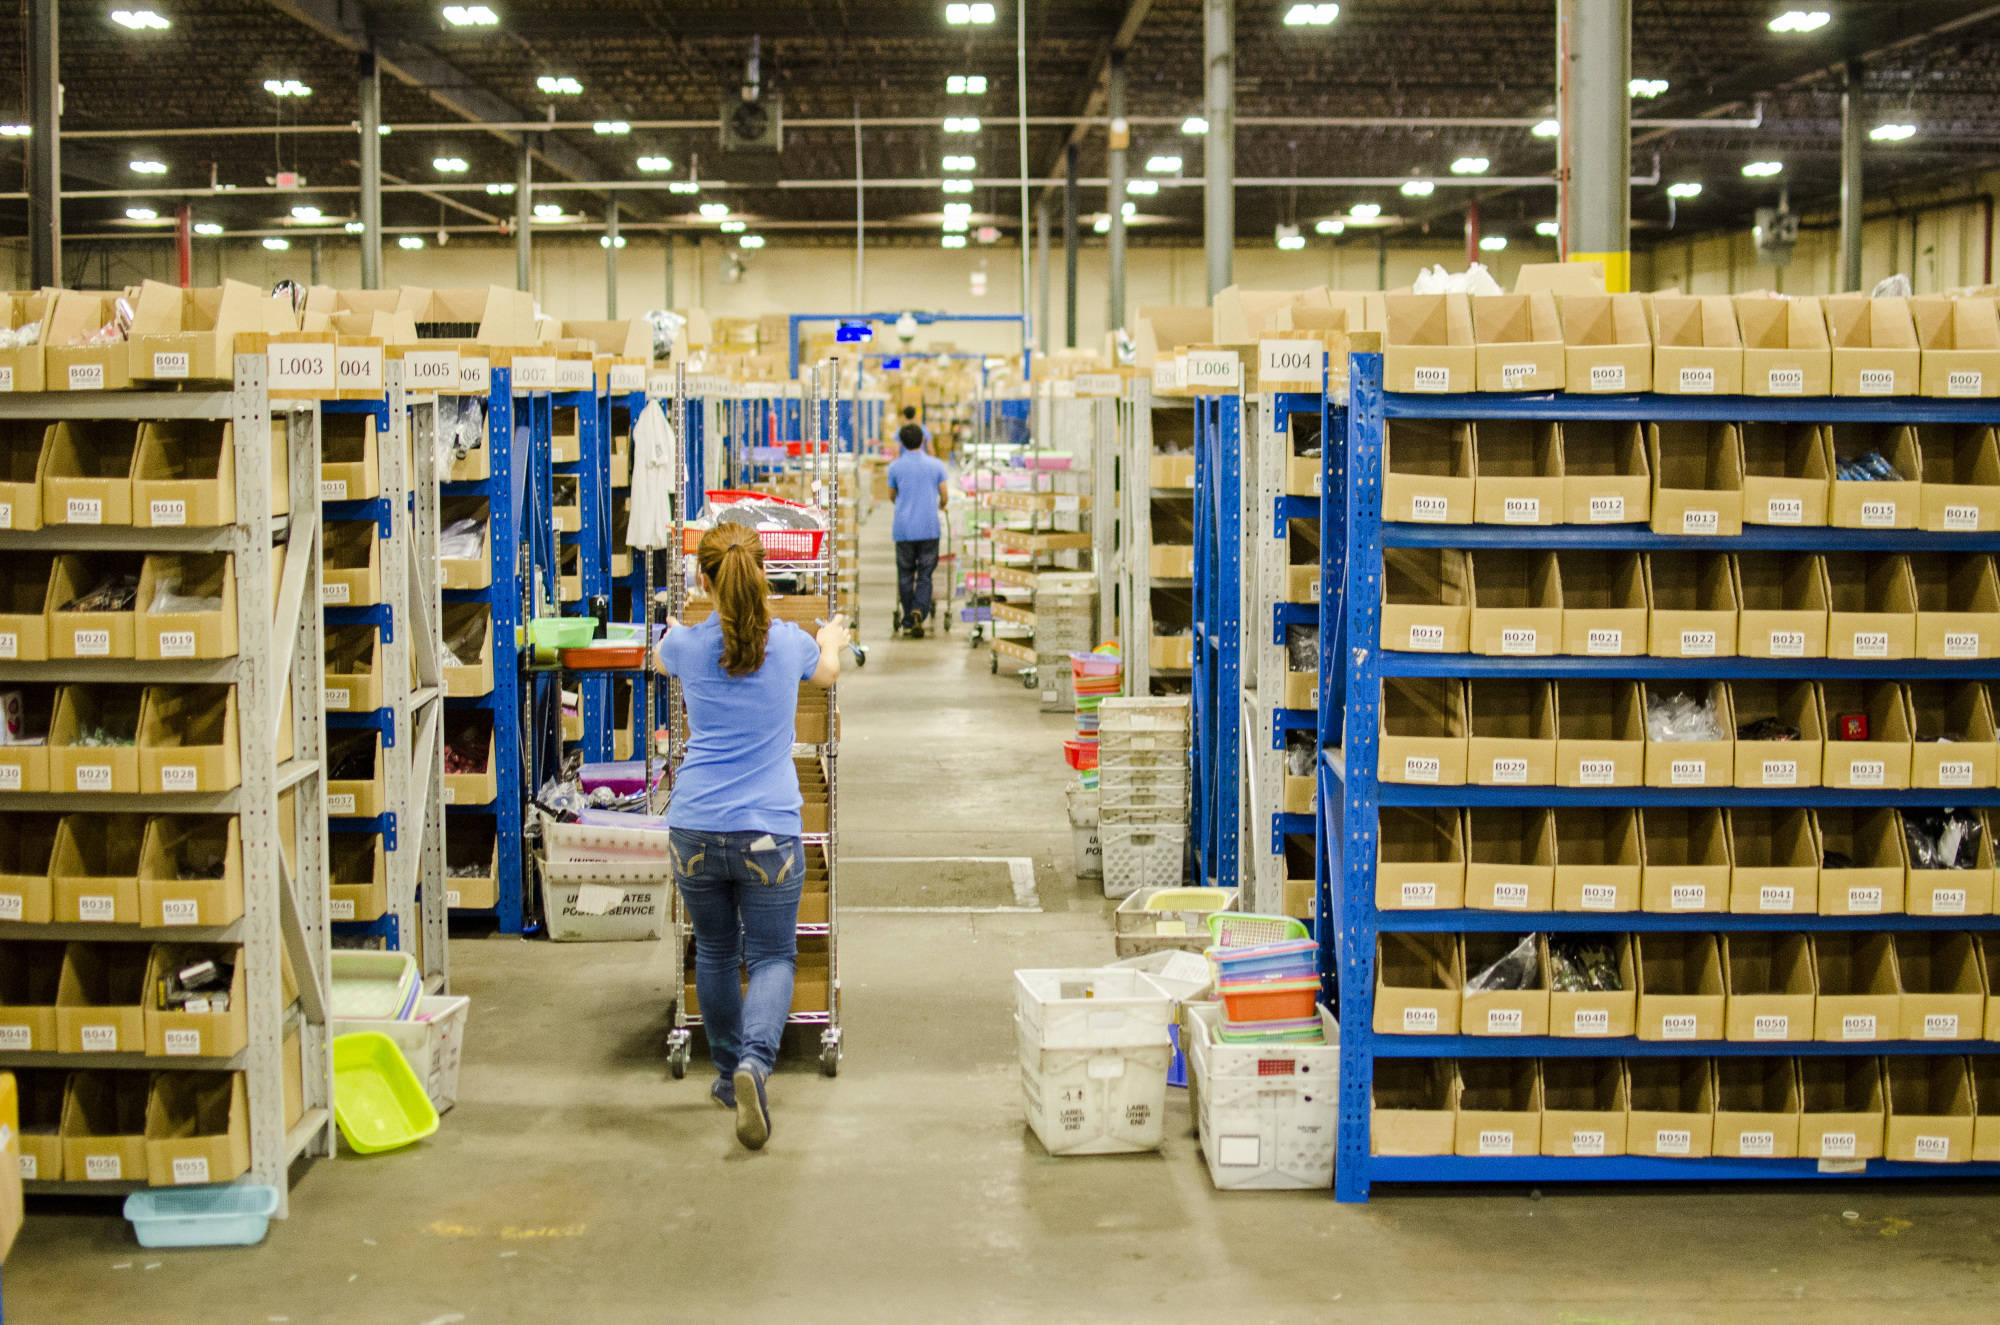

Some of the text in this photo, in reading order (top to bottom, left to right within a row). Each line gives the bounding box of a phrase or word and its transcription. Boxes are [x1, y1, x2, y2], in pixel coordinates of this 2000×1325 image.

[157, 356, 186, 365] B001
[1270, 352, 1312, 369] L004
[278, 358, 323, 376] L003
[338, 360, 371, 376] 004
[414, 363, 450, 377] L005
[1196, 362, 1230, 375] L006
[71, 369, 100, 378] B002
[514, 368, 547, 382] L007
[558, 369, 585, 384] 008
[1417, 370, 1447, 380] B001
[1592, 370, 1623, 379] B003
[1682, 372, 1712, 381] B004
[1771, 374, 1801, 382] B005
[1862, 374, 1892, 382] B006
[1950, 376, 1980, 384] B007
[70, 502, 99, 512] B011
[154, 504, 183, 513] B010
[1415, 500, 1445, 510] B010
[1507, 502, 1536, 511] B011
[1592, 501, 1622, 510] B012
[1770, 503, 1800, 512] B014
[1864, 506, 1893, 515] B015
[1946, 510, 1976, 519] B016
[1686, 515, 1716, 524] B013
[1412, 629, 1442, 638] B019
[1504, 633, 1534, 643] B020
[1590, 633, 1619, 643] B021
[77, 634, 106, 643] B020
[163, 636, 192, 644] B019
[1684, 635, 1713, 644] B022
[1772, 636, 1802, 644] B023
[1856, 636, 1886, 646] B024
[1946, 637, 1976, 646] B025
[1408, 760, 1438, 770] B028
[1495, 763, 1525, 772] B029
[1582, 764, 1612, 773] B030
[1674, 765, 1702, 773] B031
[1764, 764, 1794, 774] B032
[1852, 766, 1882, 774] B033
[1941, 766, 1970, 774] B034
[79, 770, 109, 780] B029
[164, 770, 194, 780] B028
[1404, 886, 1434, 896] B037
[1496, 887, 1526, 897] B038
[1584, 888, 1614, 898] B039
[1673, 888, 1703, 898] B040
[1762, 890, 1792, 900] B041
[623, 894, 651, 903] ATES
[1850, 891, 1880, 901] B042
[1935, 892, 1964, 902] B043
[81, 900, 112, 910] B038
[165, 903, 195, 913] B037
[608, 906, 655, 915] SERVICE
[1406, 1011, 1436, 1021] B046
[1490, 1013, 1520, 1022] B047
[1577, 1014, 1606, 1023] B048
[1664, 1019, 1694, 1028] B049
[1756, 1019, 1786, 1028] B050
[1844, 1019, 1874, 1028] B051
[1927, 1018, 1956, 1027] B052
[84, 1030, 113, 1039] B047
[168, 1034, 197, 1043] B046
[1482, 1135, 1511, 1144] B056
[1573, 1135, 1603, 1144] B057
[1658, 1133, 1688, 1143] B058
[1742, 1136, 1772, 1145] B059
[1824, 1137, 1854, 1147] B060
[1918, 1139, 1947, 1149] B061
